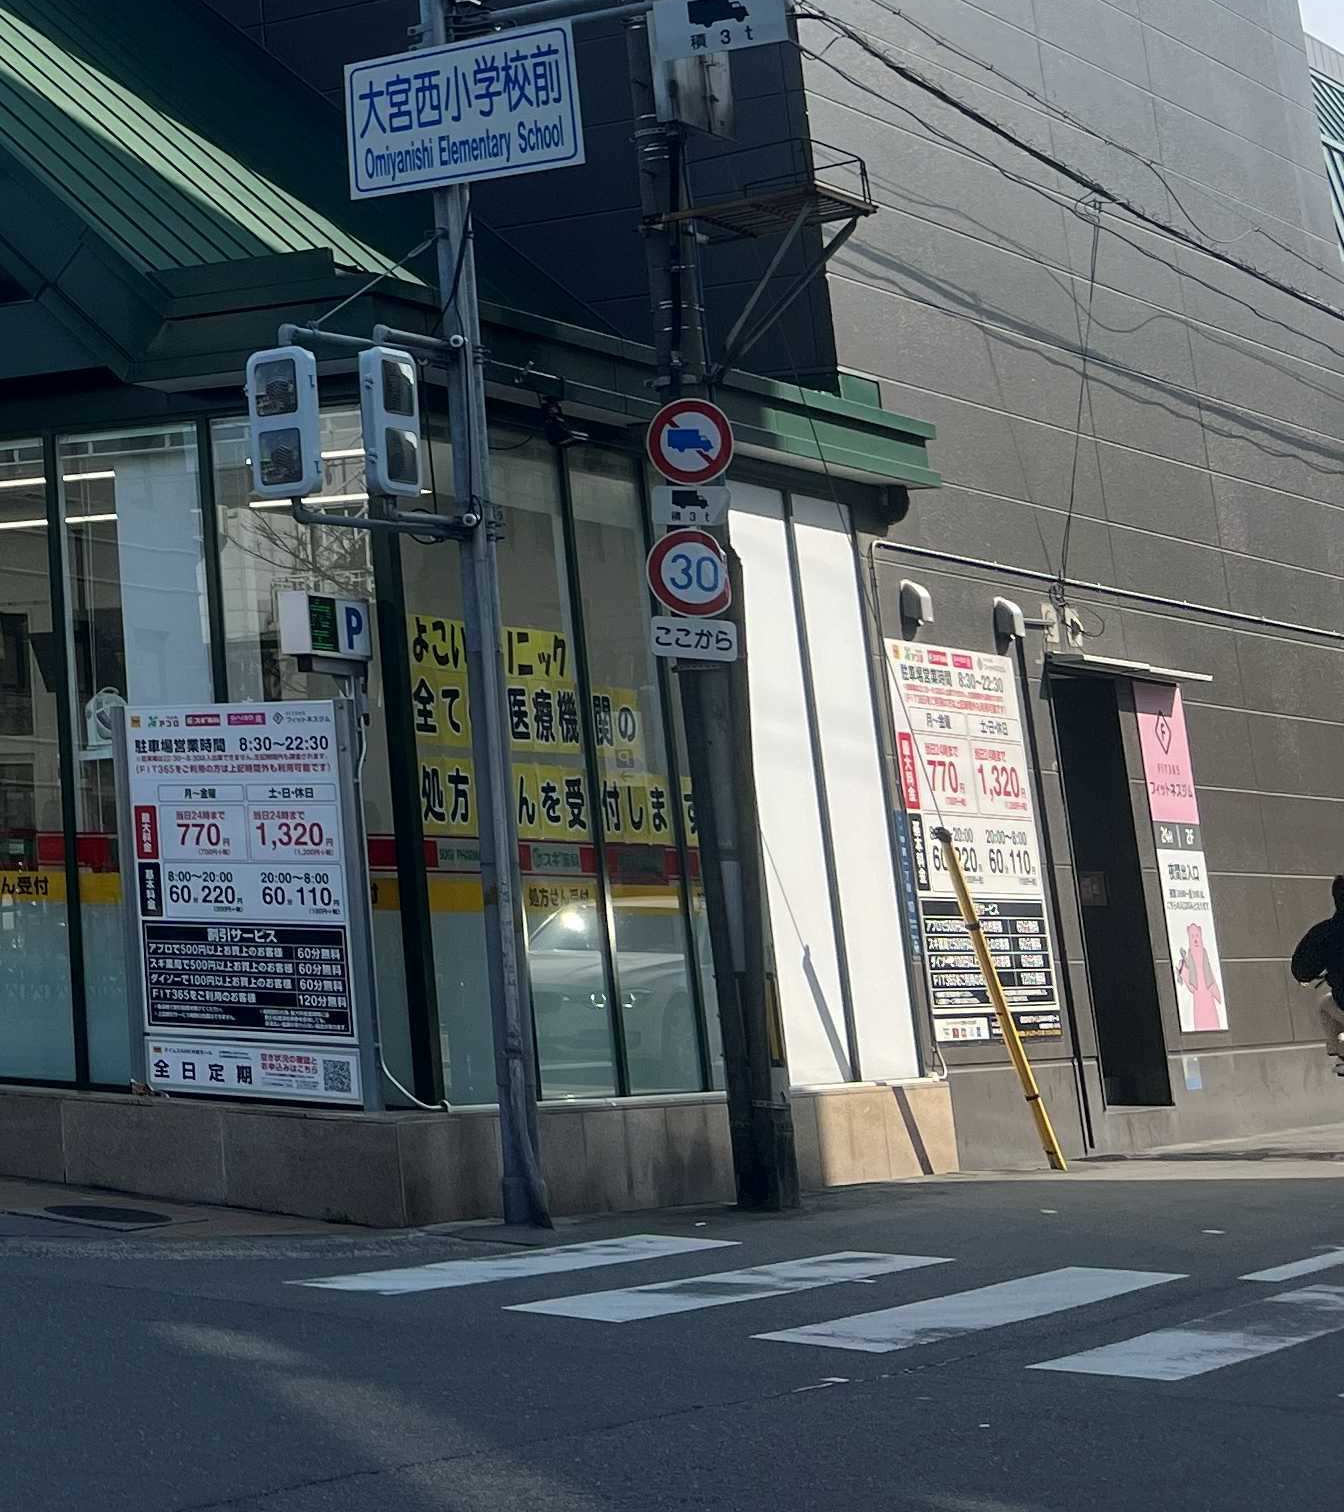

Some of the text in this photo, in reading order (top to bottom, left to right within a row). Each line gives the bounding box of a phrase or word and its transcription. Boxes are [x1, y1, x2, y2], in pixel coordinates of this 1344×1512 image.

[359, 43, 562, 139] 大宮西小学校前
[365, 115, 565, 181] Omiyanishi Elementary School
[670, 554, 719, 592] 30
[345, 606, 363, 650] P
[413, 616, 566, 677] よこいニック
[655, 626, 733, 651] ここから
[413, 677, 637, 748] 全て医療機関の
[134, 738, 226, 753] 駐車場営業時間
[422, 765, 699, 836] 処方んを受付します
[207, 928, 278, 943] 割引サービス
